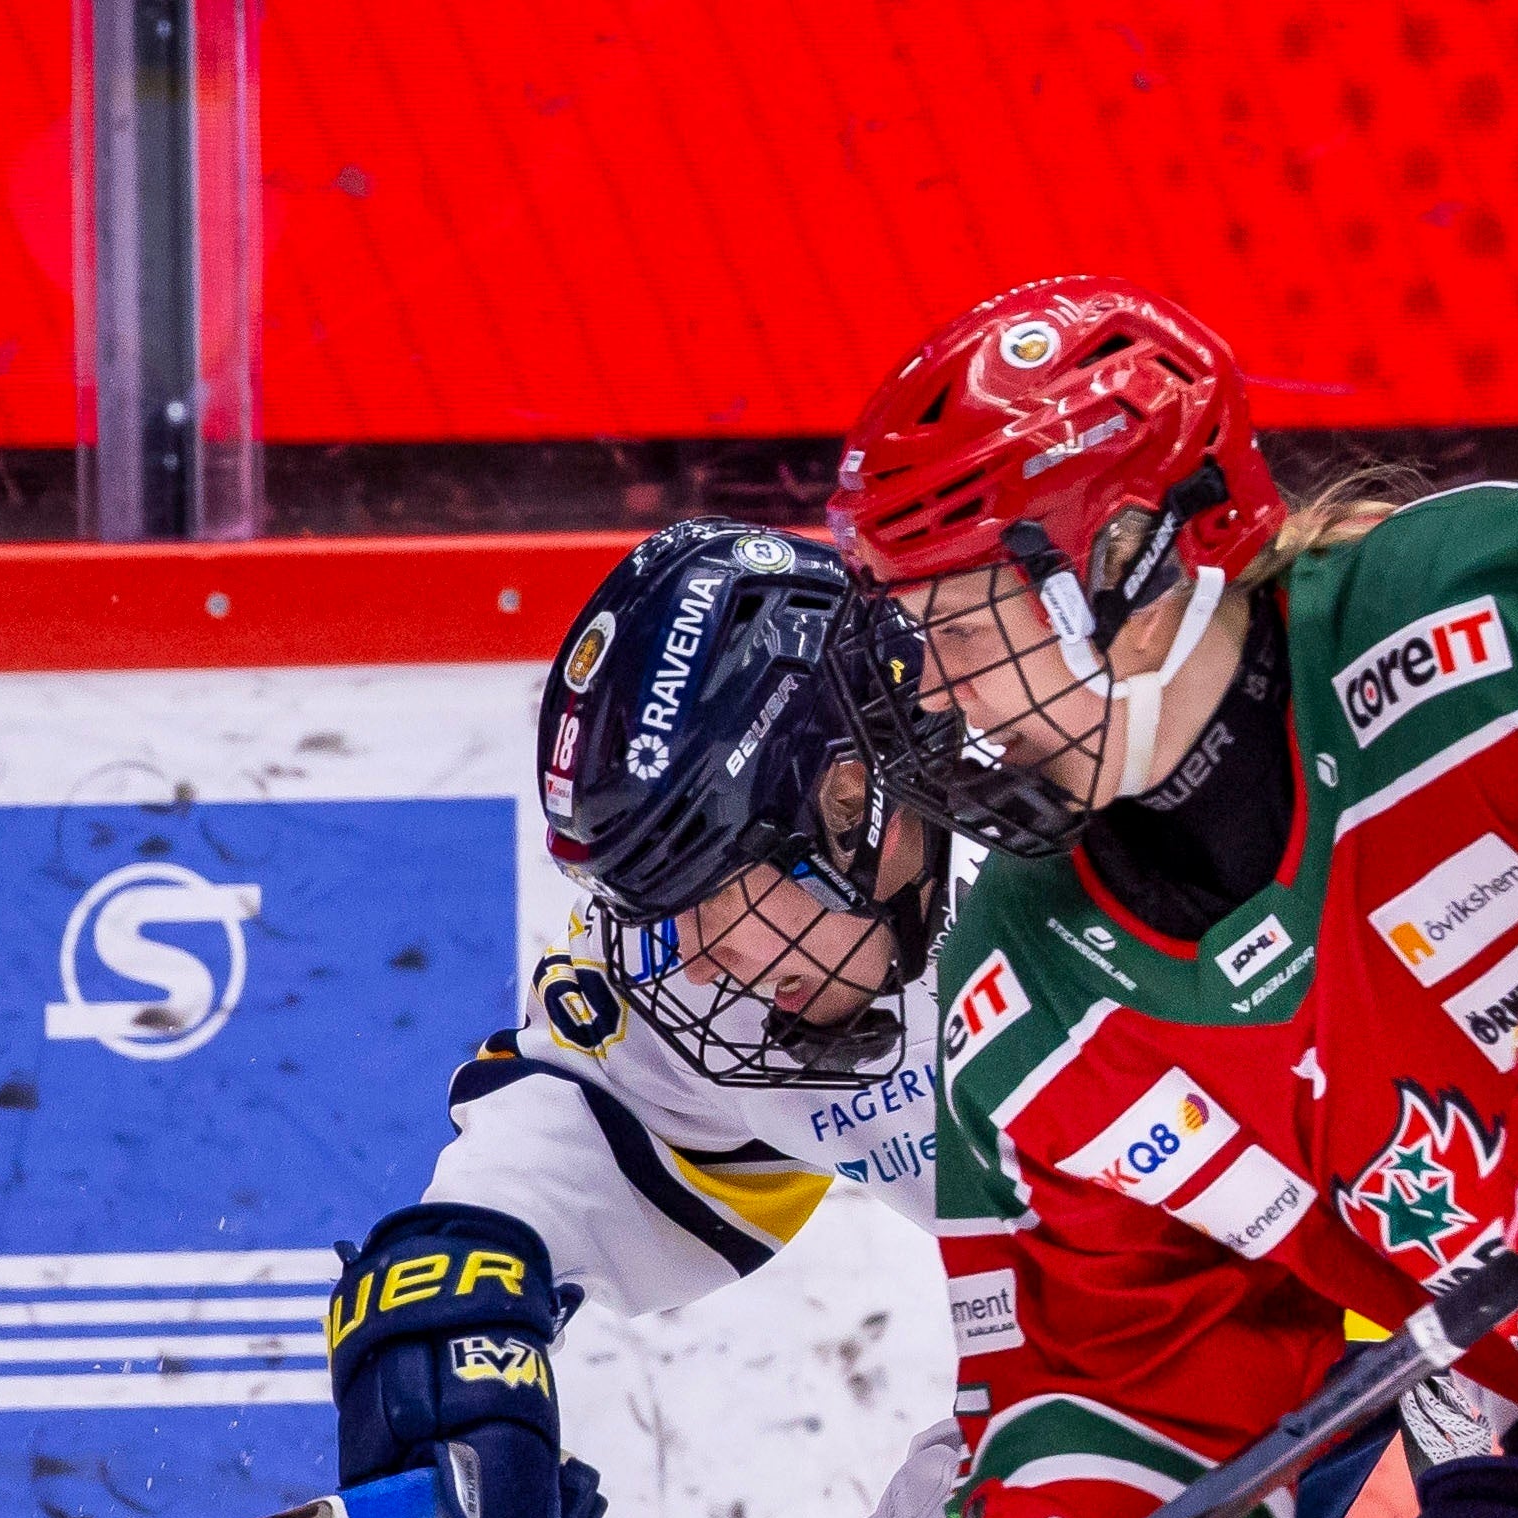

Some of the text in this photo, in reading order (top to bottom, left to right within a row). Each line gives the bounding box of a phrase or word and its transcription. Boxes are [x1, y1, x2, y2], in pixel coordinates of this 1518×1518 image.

[642, 573, 726, 732] RAVEMA
[552, 712, 580, 771] 18
[323, 1250, 525, 1352] UER
